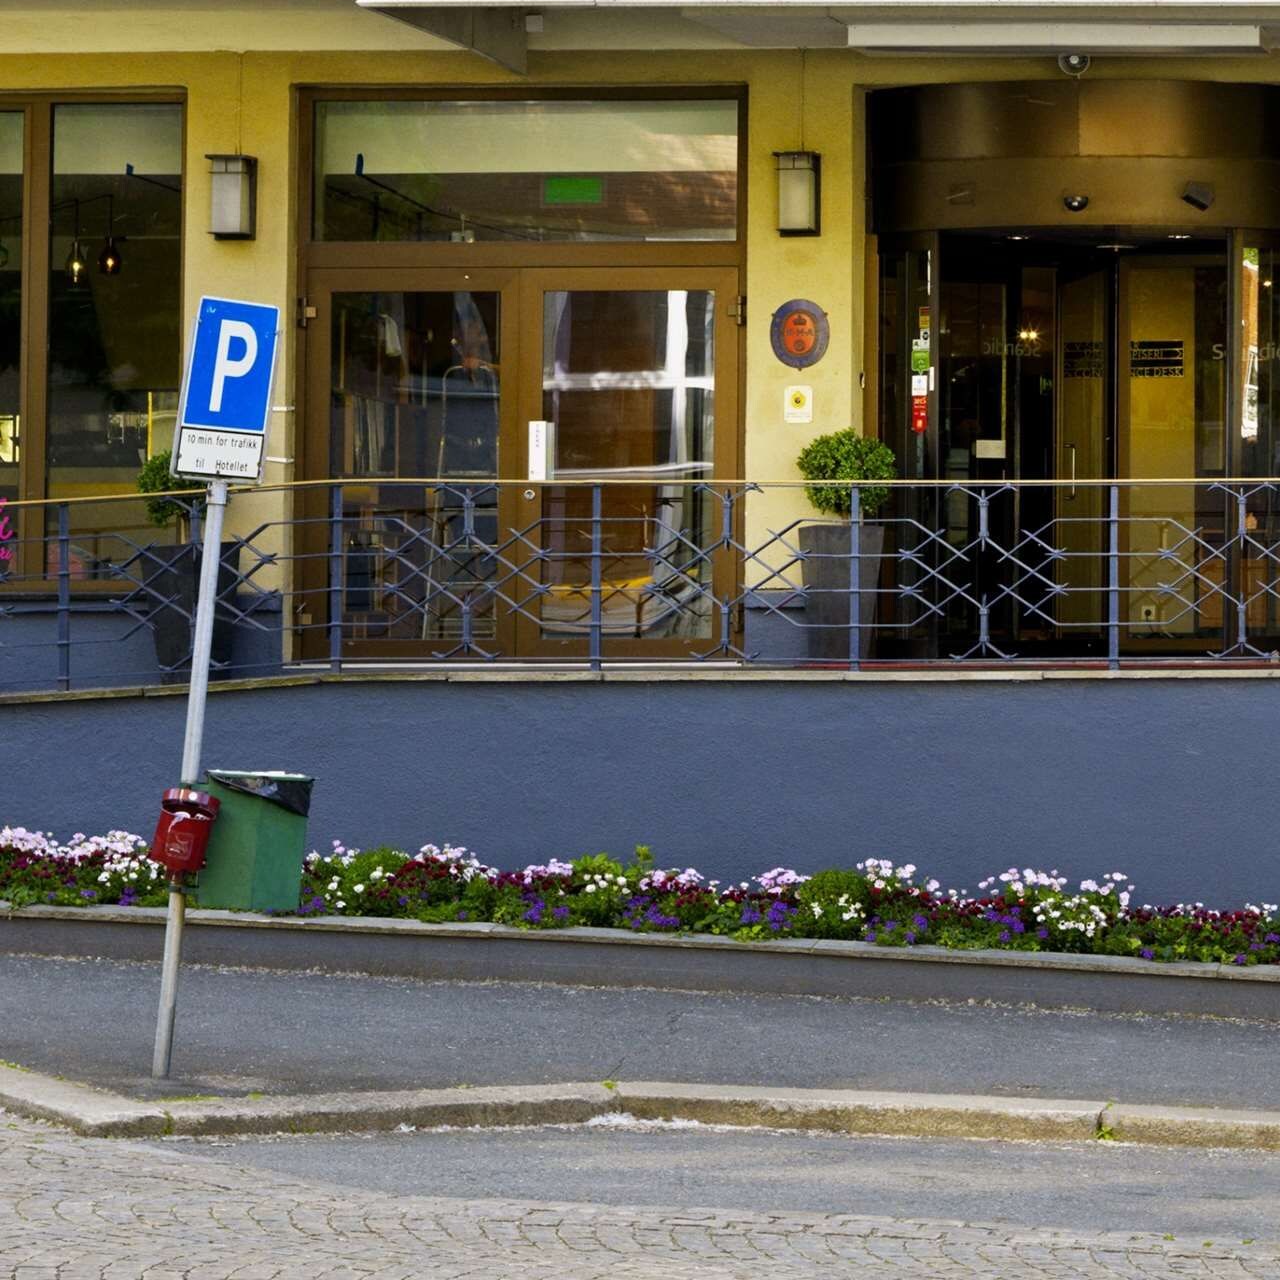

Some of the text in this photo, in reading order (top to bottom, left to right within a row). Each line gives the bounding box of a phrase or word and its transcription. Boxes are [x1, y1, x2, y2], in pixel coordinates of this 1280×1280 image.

[209, 319, 258, 413] P
[187, 434, 196, 444] 10
[197, 435, 213, 445] min
[231, 437, 257, 449] trafikk
[195, 458, 248, 472] til Hotellet
